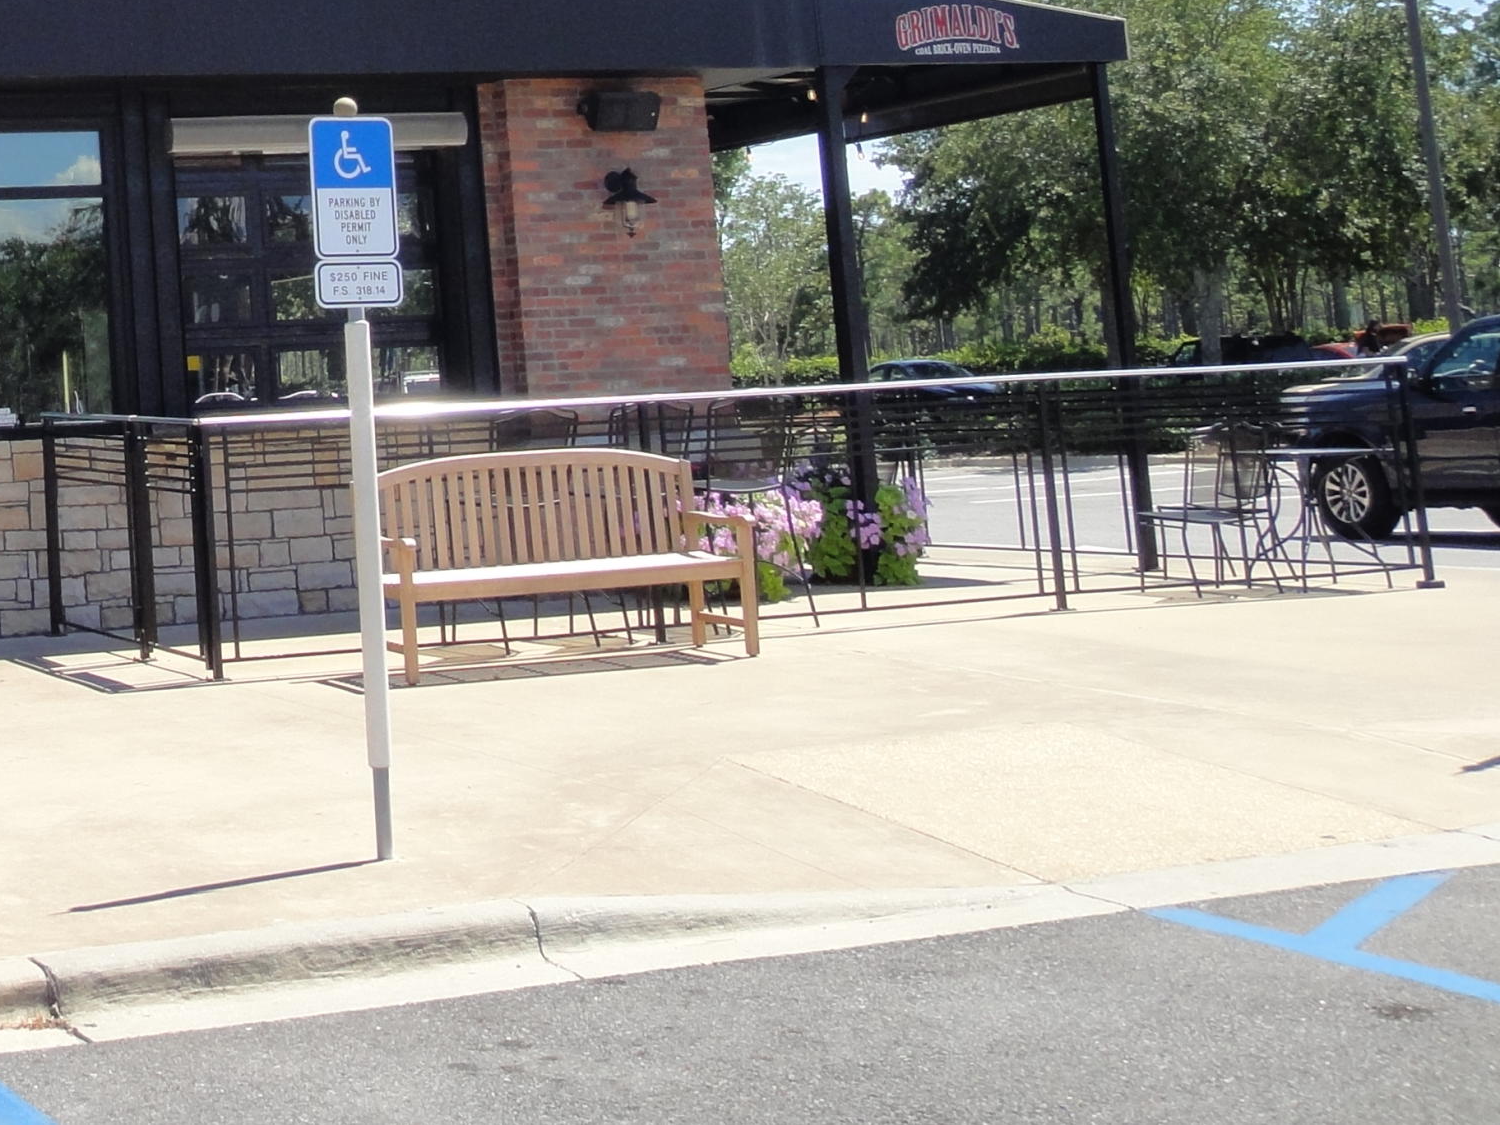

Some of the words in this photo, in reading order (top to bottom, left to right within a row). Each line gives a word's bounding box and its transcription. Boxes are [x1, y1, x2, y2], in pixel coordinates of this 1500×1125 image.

[895, 3, 1019, 51] GRIMALDI'S
[328, 197, 366, 208] PARKING
[369, 196, 381, 207] BY
[334, 209, 376, 220] DISABLED
[341, 221, 371, 232] PERMIT
[346, 234, 368, 245] ONLY
[330, 271, 358, 282] $250
[363, 270, 388, 281] FINE
